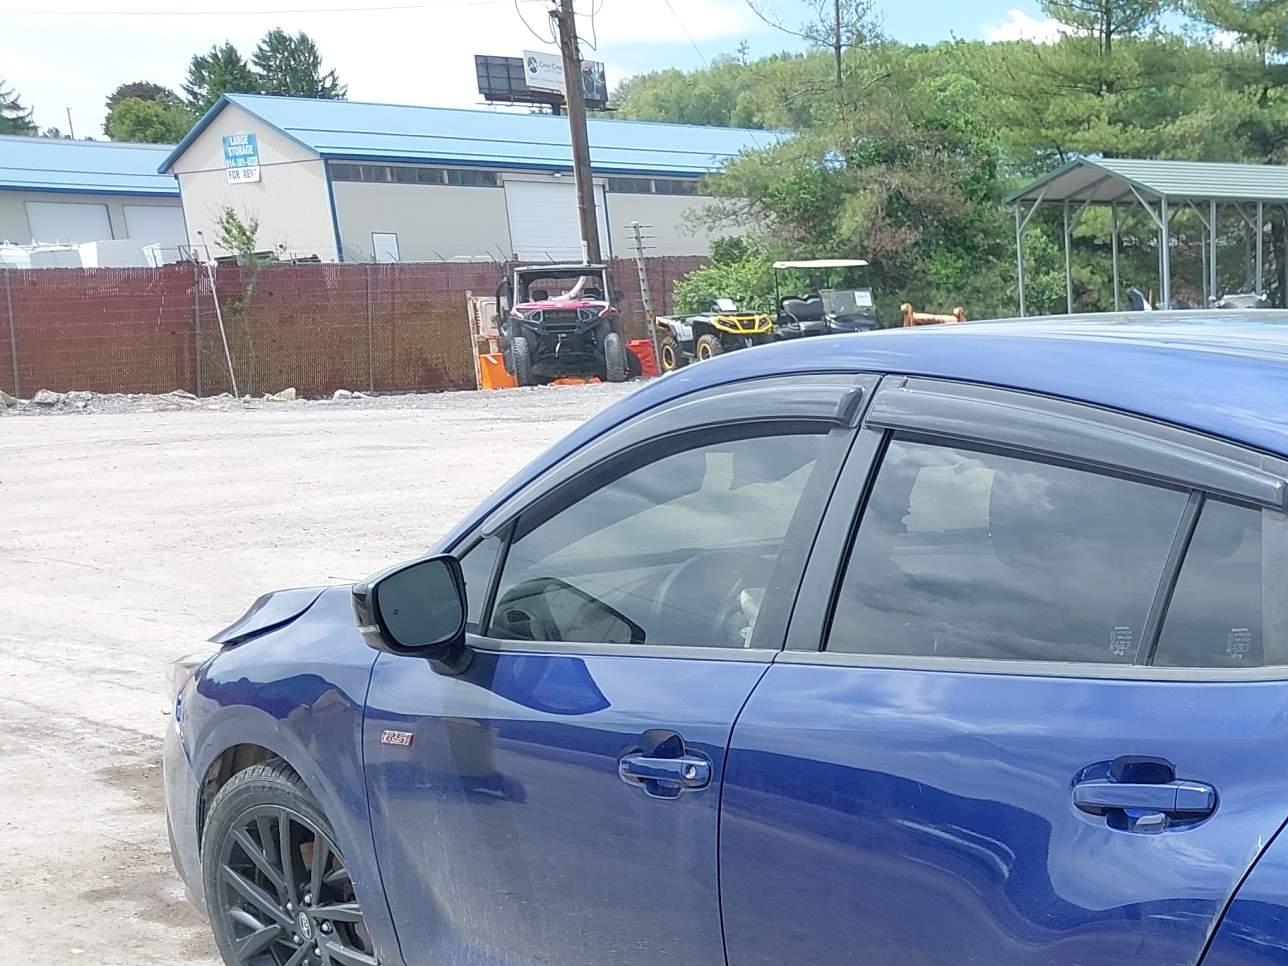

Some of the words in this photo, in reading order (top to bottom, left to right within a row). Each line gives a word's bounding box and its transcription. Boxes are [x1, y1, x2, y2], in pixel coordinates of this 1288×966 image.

[228, 145, 255, 157] STORAGE
[228, 169, 241, 181] FOR
[243, 168, 257, 179] RENT
